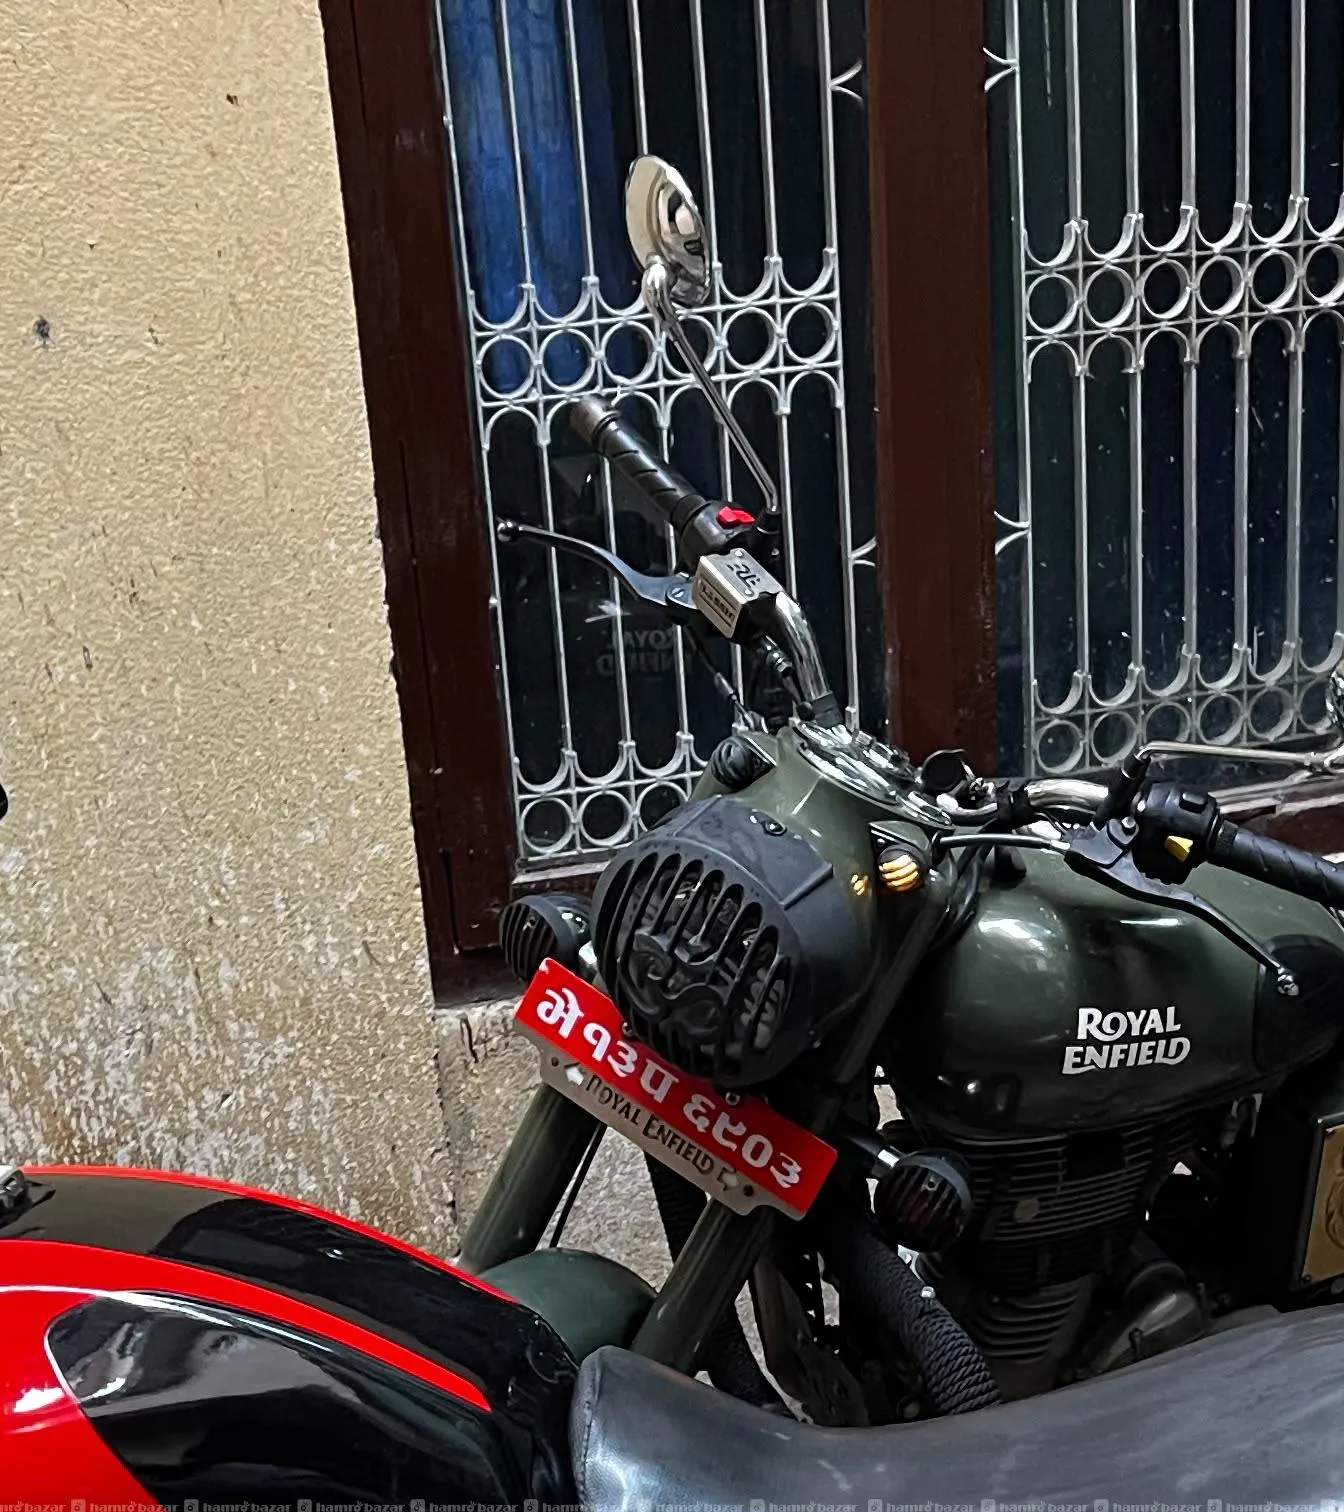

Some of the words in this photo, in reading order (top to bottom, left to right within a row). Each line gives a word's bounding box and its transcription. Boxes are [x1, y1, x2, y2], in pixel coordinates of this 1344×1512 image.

[1077, 1006, 1181, 1041] ROYAL
[1062, 1037, 1191, 1075] ENFIELD
[585, 1074, 641, 1126] ROYAL
[642, 1114, 714, 1175] ENFIELD
